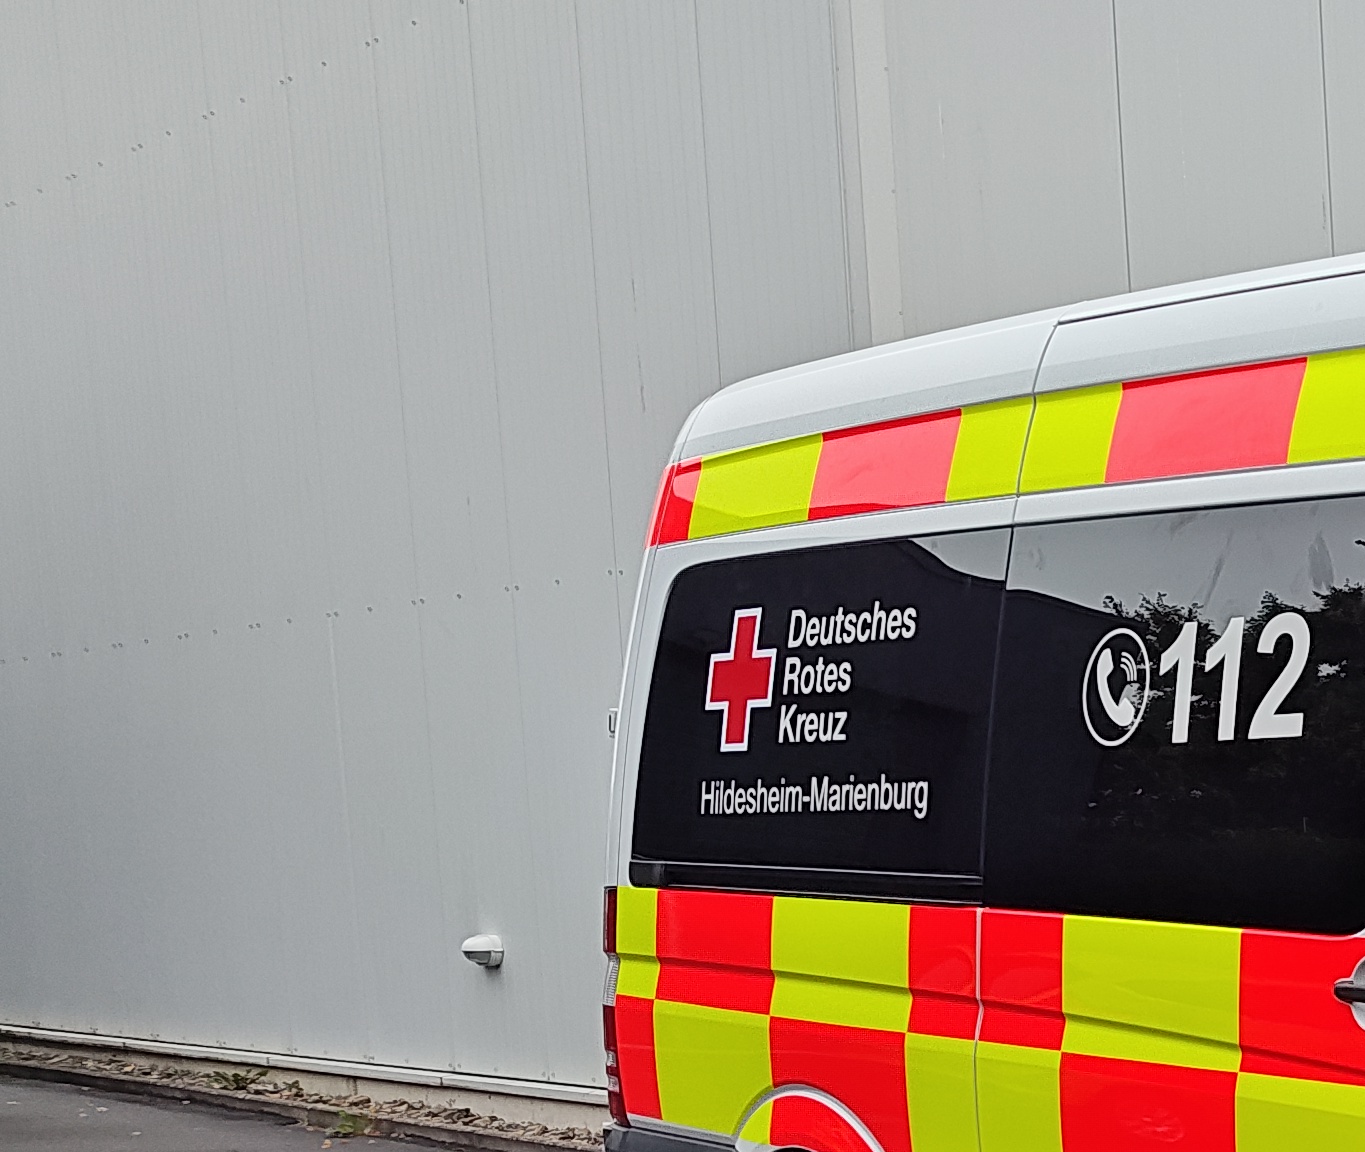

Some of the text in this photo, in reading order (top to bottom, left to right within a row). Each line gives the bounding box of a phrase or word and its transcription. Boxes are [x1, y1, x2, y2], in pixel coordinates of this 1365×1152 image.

[787, 600, 917, 649] Deutsches
[782, 656, 852, 695] Rotes
[1158, 611, 1311, 744] 112
[778, 704, 848, 743] Kreuz
[700, 773, 929, 820] Hildesheim-Marienburg
